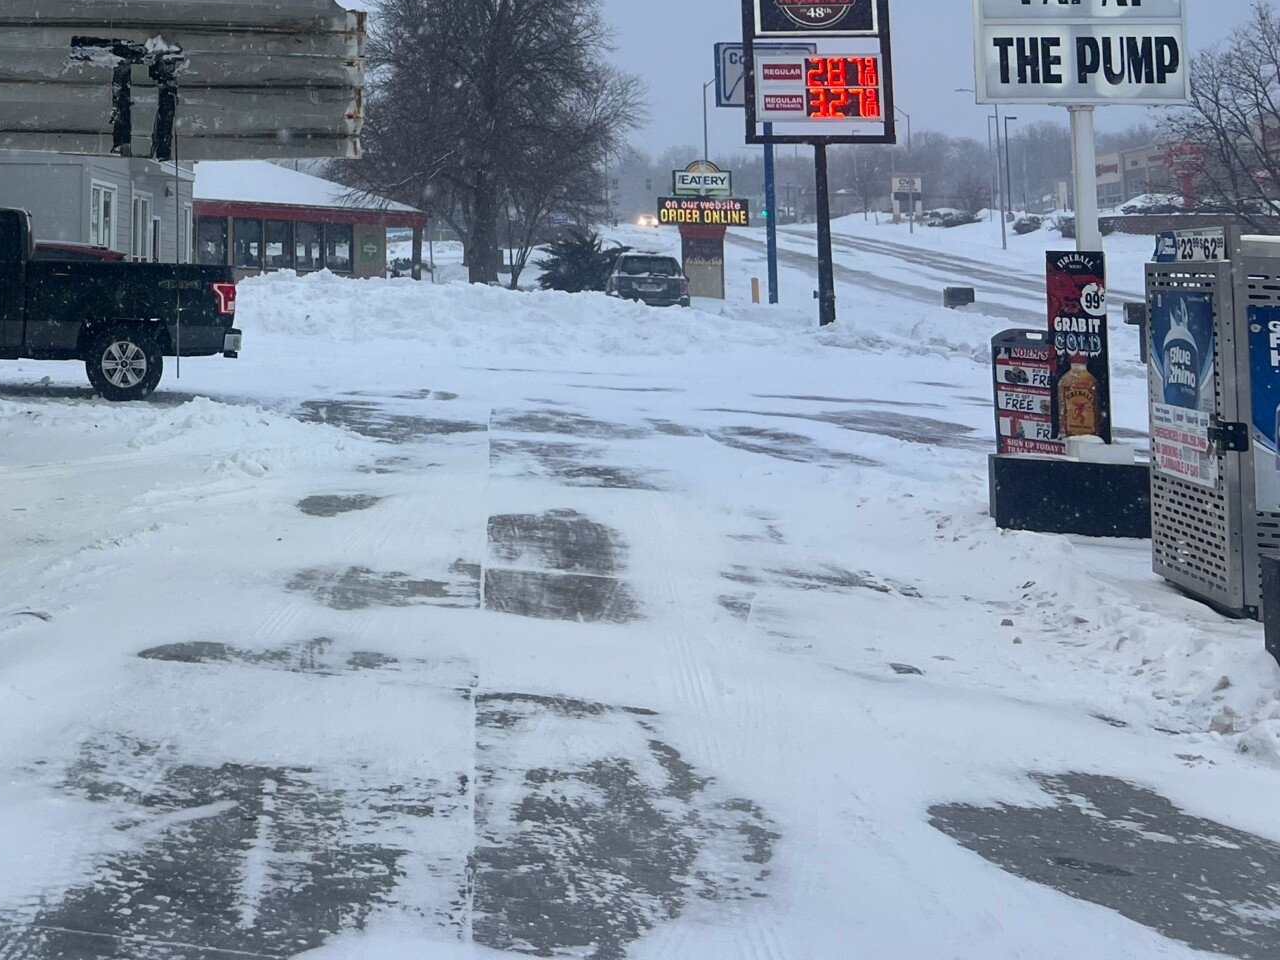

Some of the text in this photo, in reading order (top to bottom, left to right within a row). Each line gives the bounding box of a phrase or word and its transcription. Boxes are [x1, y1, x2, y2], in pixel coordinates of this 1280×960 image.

[806, 7, 833, 19] 48th
[992, 36, 1180, 86] THE PUMP
[763, 68, 801, 76] REGULAR
[765, 97, 803, 105] REGULAR
[681, 174, 728, 186] EATERY
[665, 200, 741, 210] on our website
[660, 209, 748, 225] ORDER ONLINE
[1056, 253, 1094, 269] FIREBALL
[1054, 316, 1101, 333] GRAB IT
[1054, 333, 1102, 356] COLD
[1011, 347, 1049, 361] NORM'S
[1169, 346, 1191, 366] Blue
[1168, 365, 1196, 388] Rhino
[1005, 398, 1034, 411] FREE
[1036, 428, 1051, 440] FR
[1007, 439, 1025, 447] SIGN
[1024, 440, 1035, 449] UP
[1036, 442, 1059, 453] TODAY
